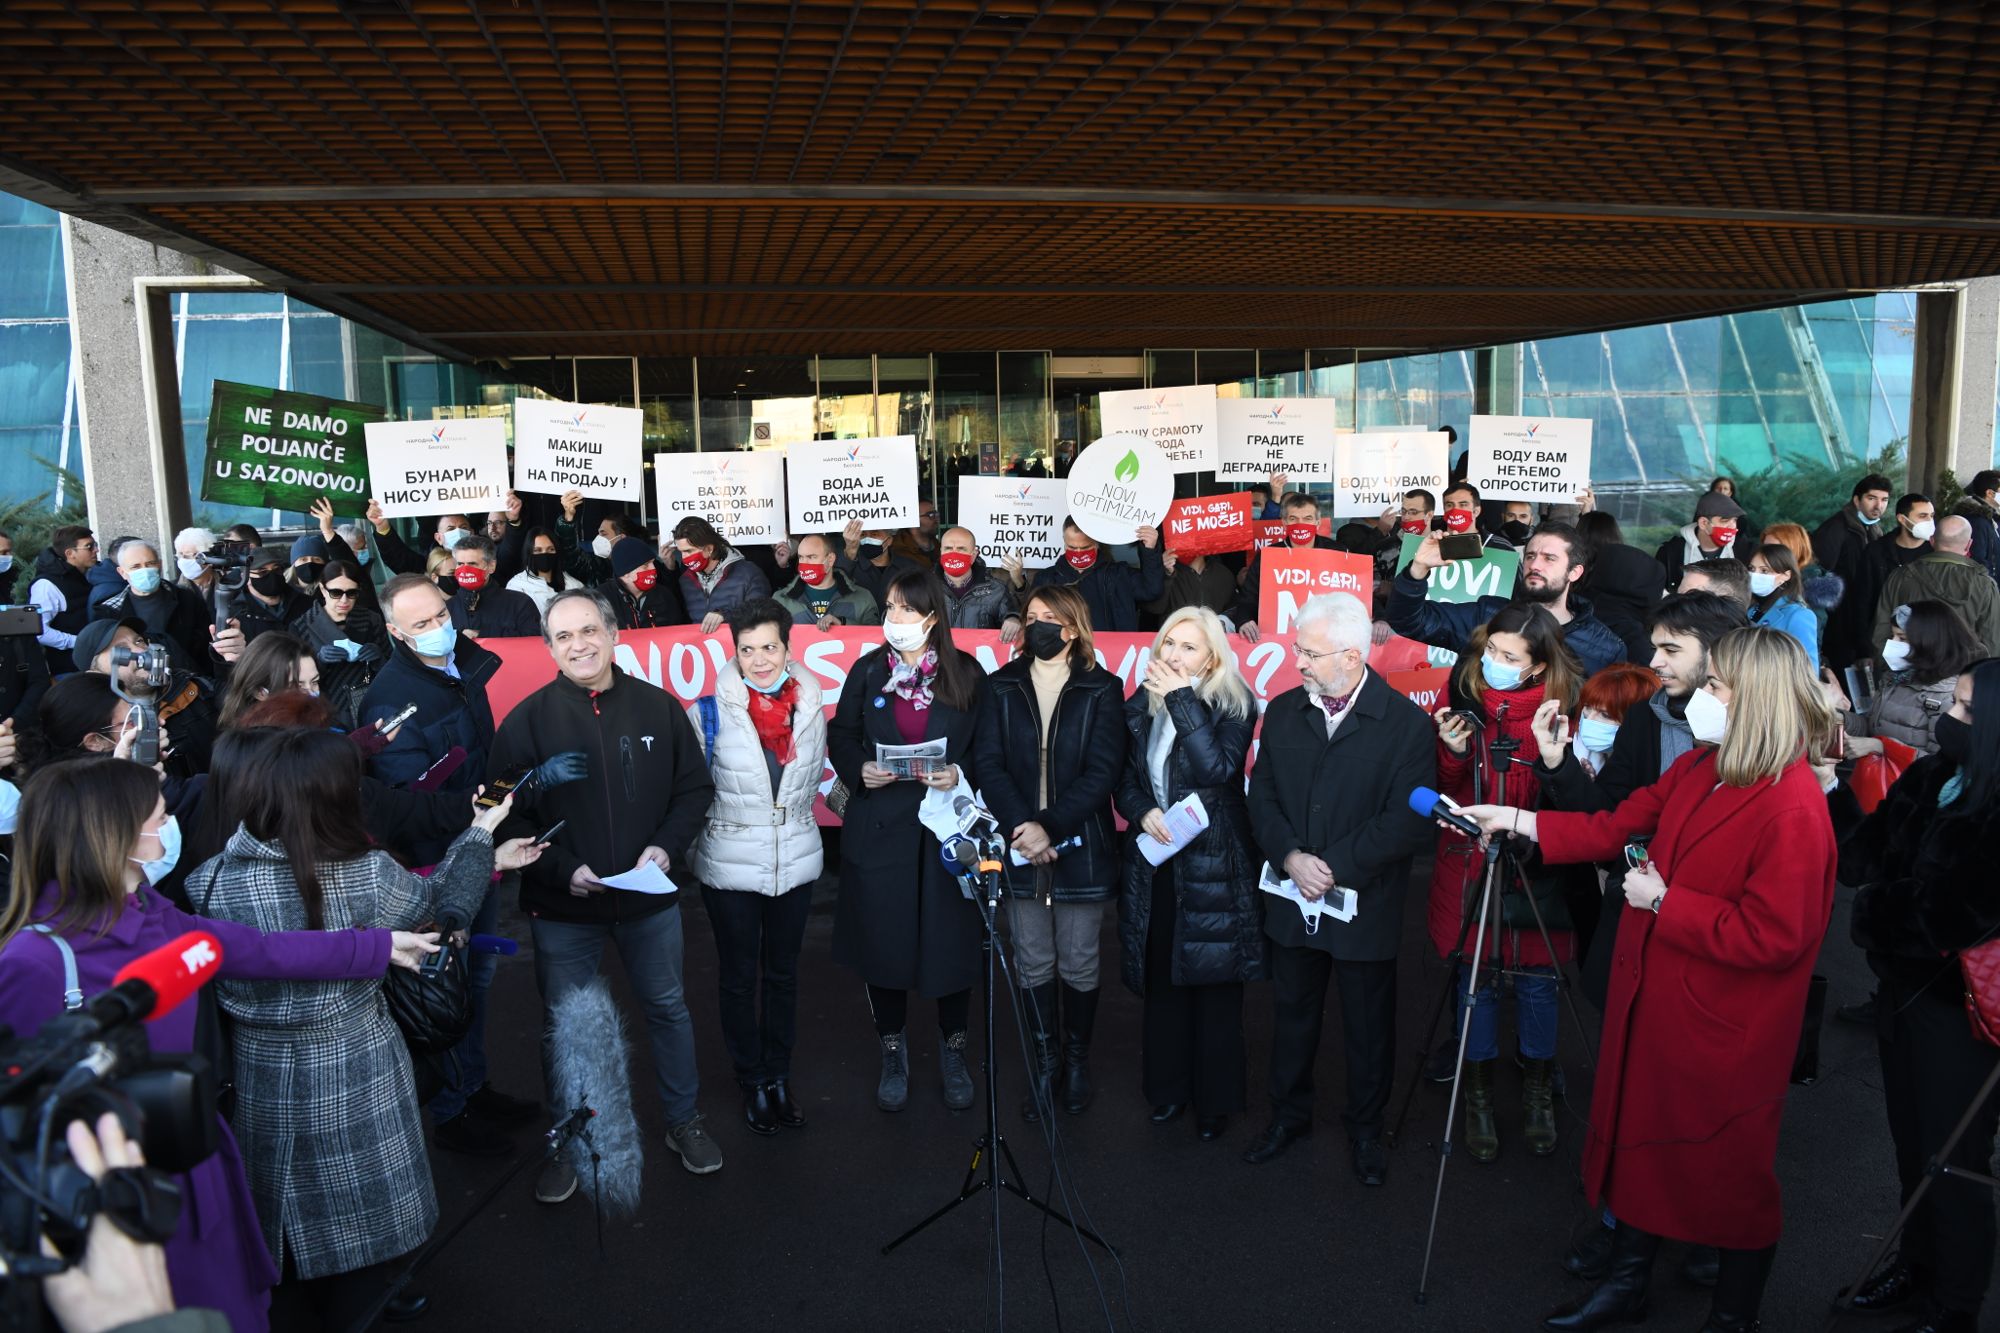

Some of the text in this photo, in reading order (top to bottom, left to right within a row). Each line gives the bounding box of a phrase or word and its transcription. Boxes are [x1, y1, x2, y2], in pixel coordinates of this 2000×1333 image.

[244, 406, 348, 437] NE DAMO
[1152, 424, 1203, 437] СРАМОТУ
[548, 438, 602, 455] МАКИШ
[1247, 435, 1304, 446] ГРАДИТЕ
[241, 433, 346, 464] POLJANČE
[1267, 449, 1283, 459] НЕ
[556, 455, 593, 470] НИЈЕ
[1493, 450, 1567, 463] ВОДУ ВАМ
[405, 467, 477, 484] БУНАРИ
[1222, 462, 1319, 474] ДЕГРАДИРАЈТЕ
[1497, 465, 1561, 478] НЕЋЕМО
[216, 460, 365, 494] U SAZONOVOJ
[528, 468, 547, 481] НА
[551, 471, 618, 488] ПРОДАЈУ
[823, 476, 885, 491] ВОДА ЈЕ
[1340, 475, 1441, 490] ВОДУ ЧУВАМО
[698, 485, 747, 498] ВАЗДУХ
[1101, 483, 1137, 504] NOVI
[1480, 479, 1568, 493] ОПРОСТИТИ
[384, 489, 432, 504] НИСУ
[437, 485, 491, 501] ВАШИ
[819, 491, 890, 507] ВАЖНИЈА
[671, 498, 774, 511] СТЕ ЗАТРОВАЛИ
[1073, 491, 1156, 525] OPTIMIZAM
[706, 513, 741, 524] ВОДУ
[803, 511, 824, 525] ОД
[828, 506, 898, 521] ПРОФИТА
[990, 513, 1053, 526] НЕ ЋУТИ
[713, 526, 724, 537] Е
[728, 525, 764, 538] ДАМО
[1171, 518, 1194, 535] NE
[994, 530, 1047, 543] ДОК ТИ
[1015, 546, 1061, 560] КРАДУ
